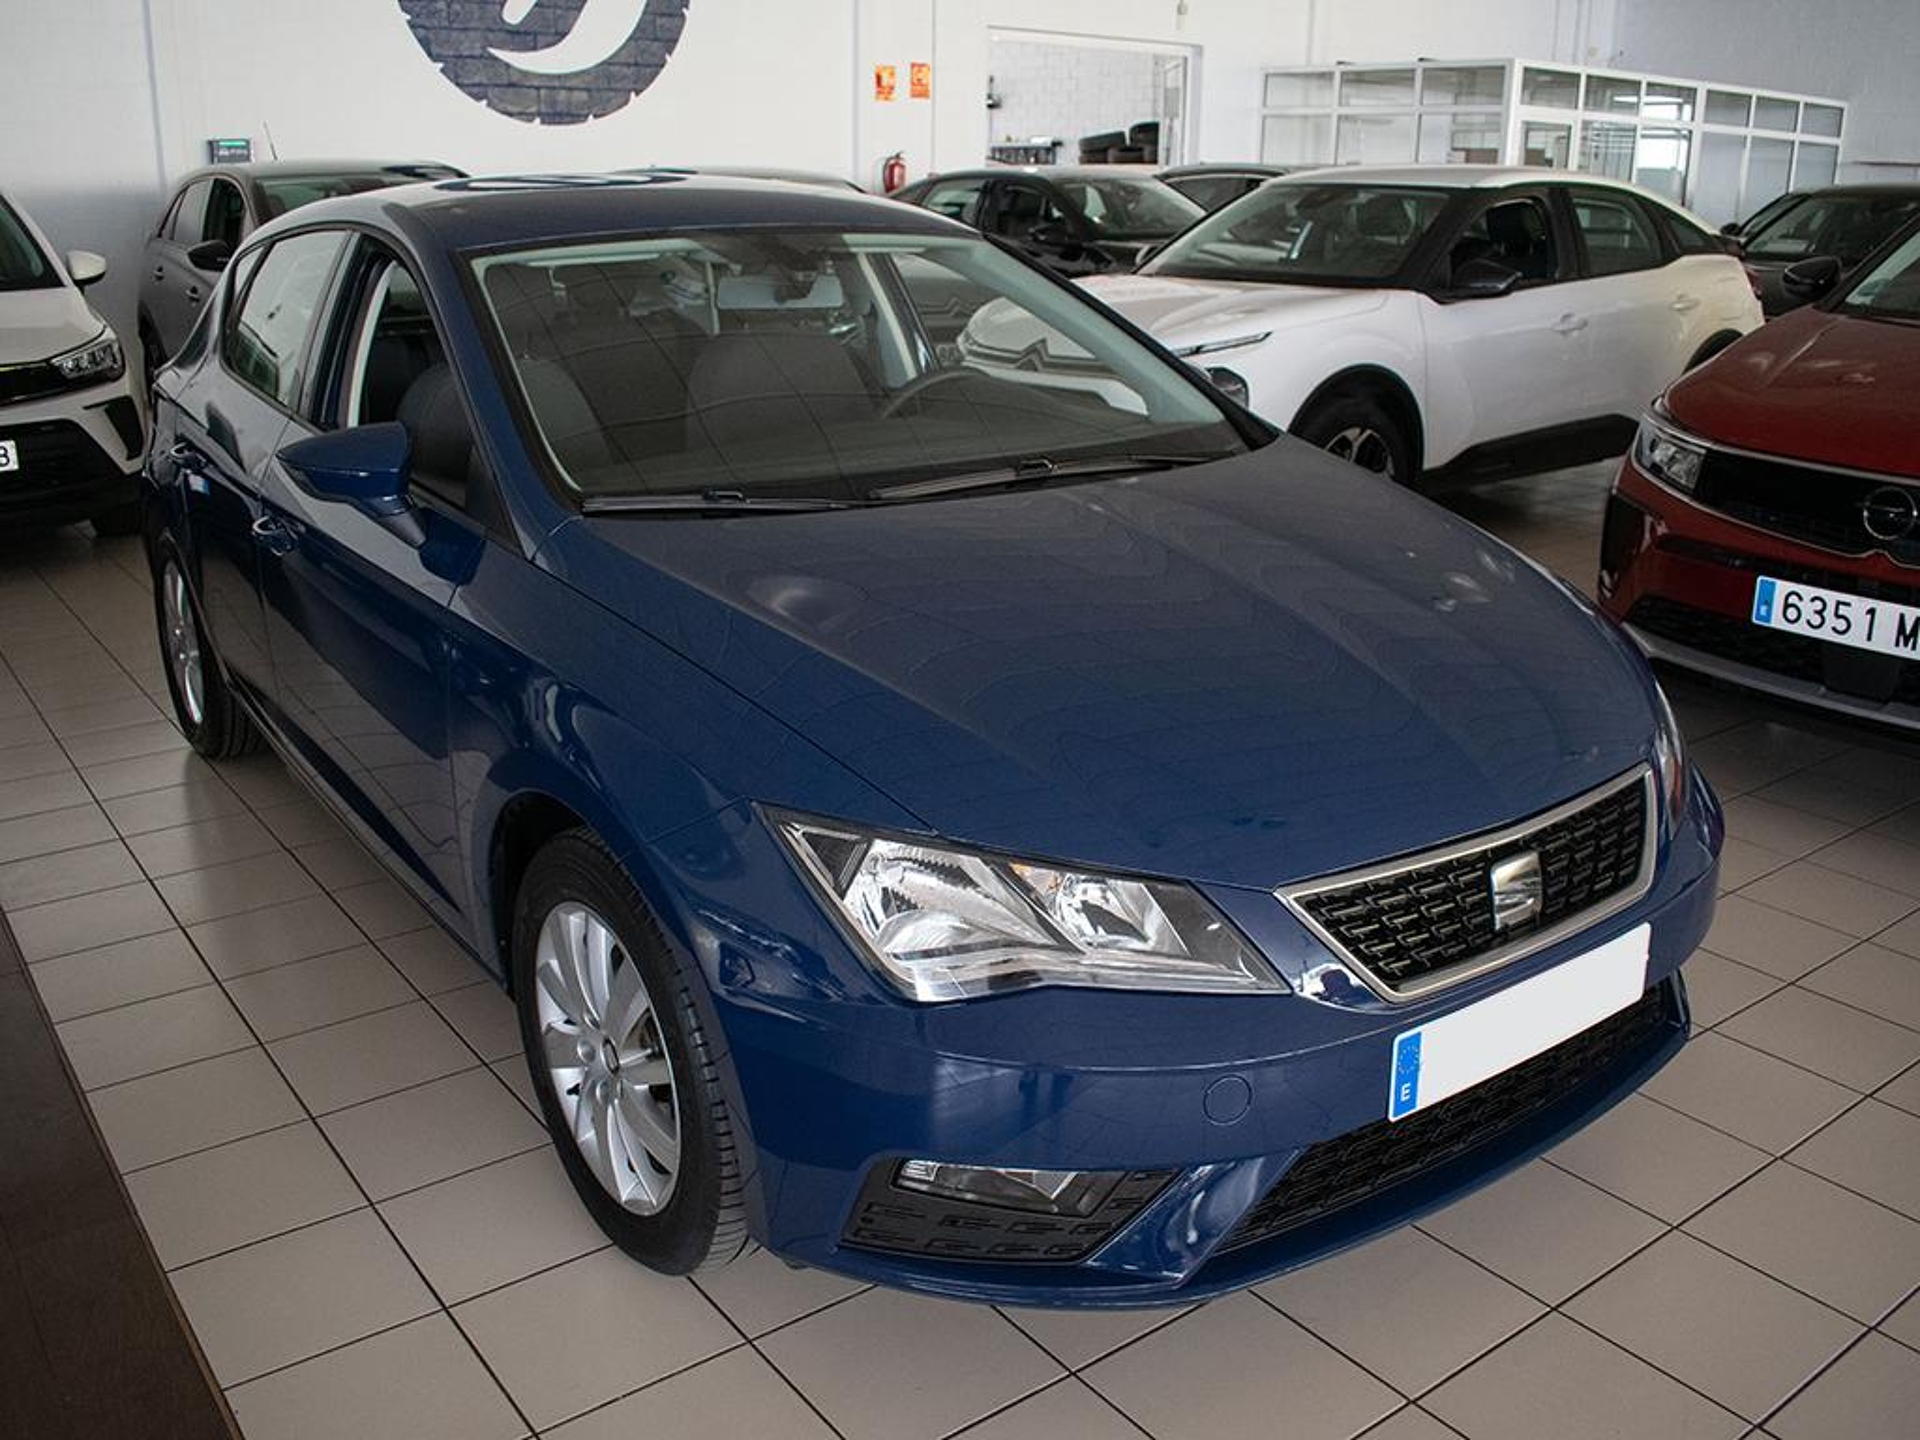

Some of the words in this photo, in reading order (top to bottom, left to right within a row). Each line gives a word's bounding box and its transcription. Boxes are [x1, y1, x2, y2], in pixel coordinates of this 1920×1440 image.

[1783, 590, 1876, 641] 6351
[1895, 613, 1920, 651] M
[1401, 1082, 1411, 1101] E
